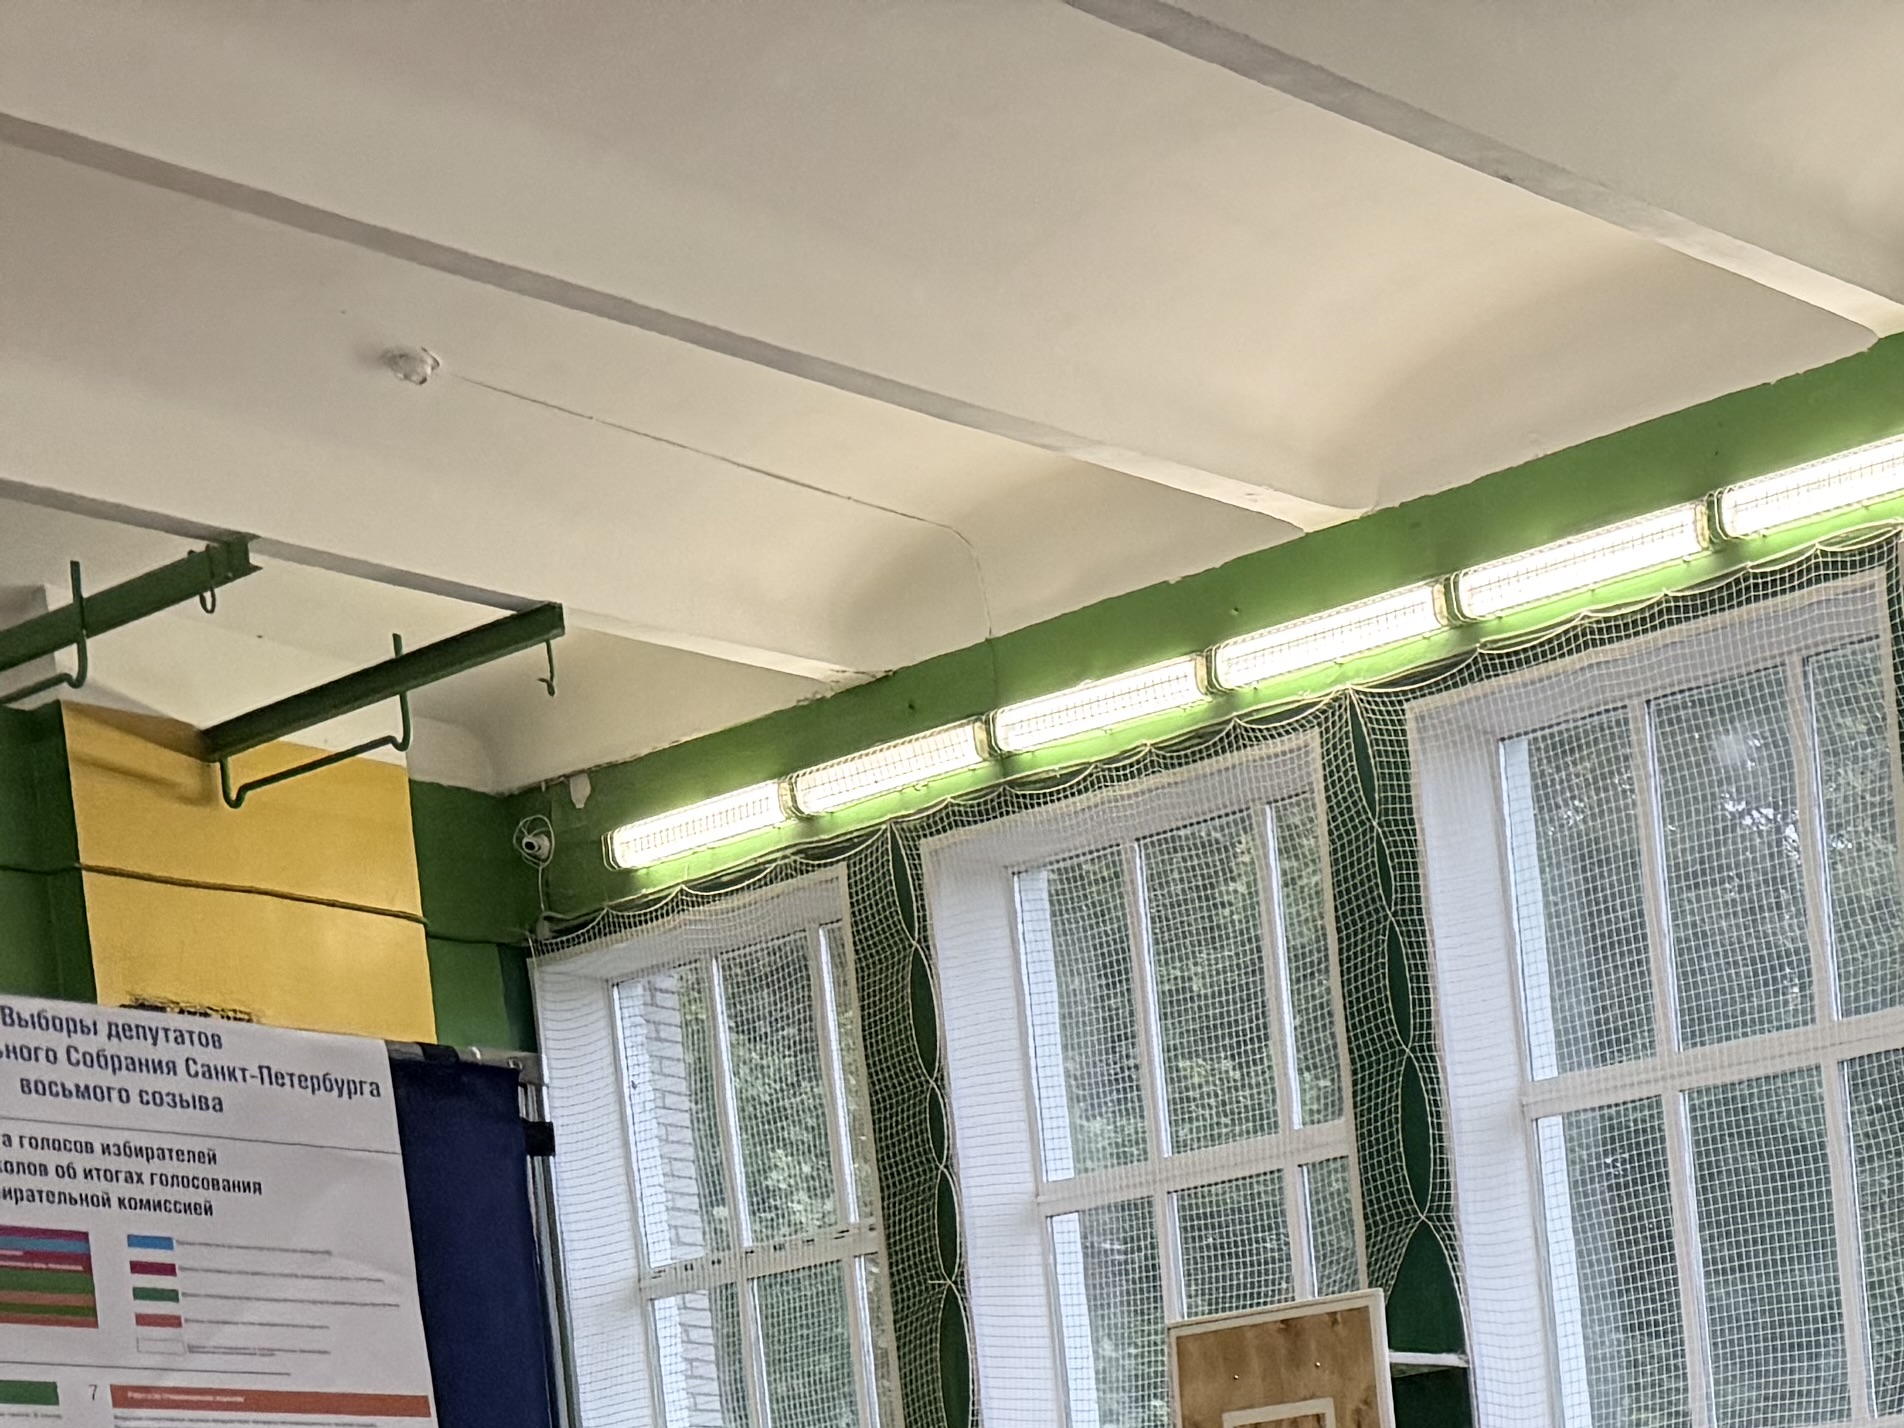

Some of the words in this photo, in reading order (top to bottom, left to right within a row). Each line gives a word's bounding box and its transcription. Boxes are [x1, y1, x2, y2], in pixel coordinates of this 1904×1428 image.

[0, 1004, 98, 1039] Выборы
[106, 1020, 223, 1050] депутатов
[65, 1044, 178, 1077] Собрания
[185, 1056, 381, 1099] Санкт-Петербурга
[20, 1077, 131, 1104] восьмого
[138, 1088, 224, 1113] созыва
[18, 1134, 95, 1155] голосов
[100, 1140, 217, 1166] избирателей
[0, 1160, 49, 1177] олов
[55, 1161, 77, 1180] об
[83, 1166, 145, 1187] итогах
[150, 1171, 262, 1196] голосования
[0, 1185, 112, 1209] ирательной
[117, 1196, 214, 1217] комиссией
[89, 1384, 98, 1401] 7
